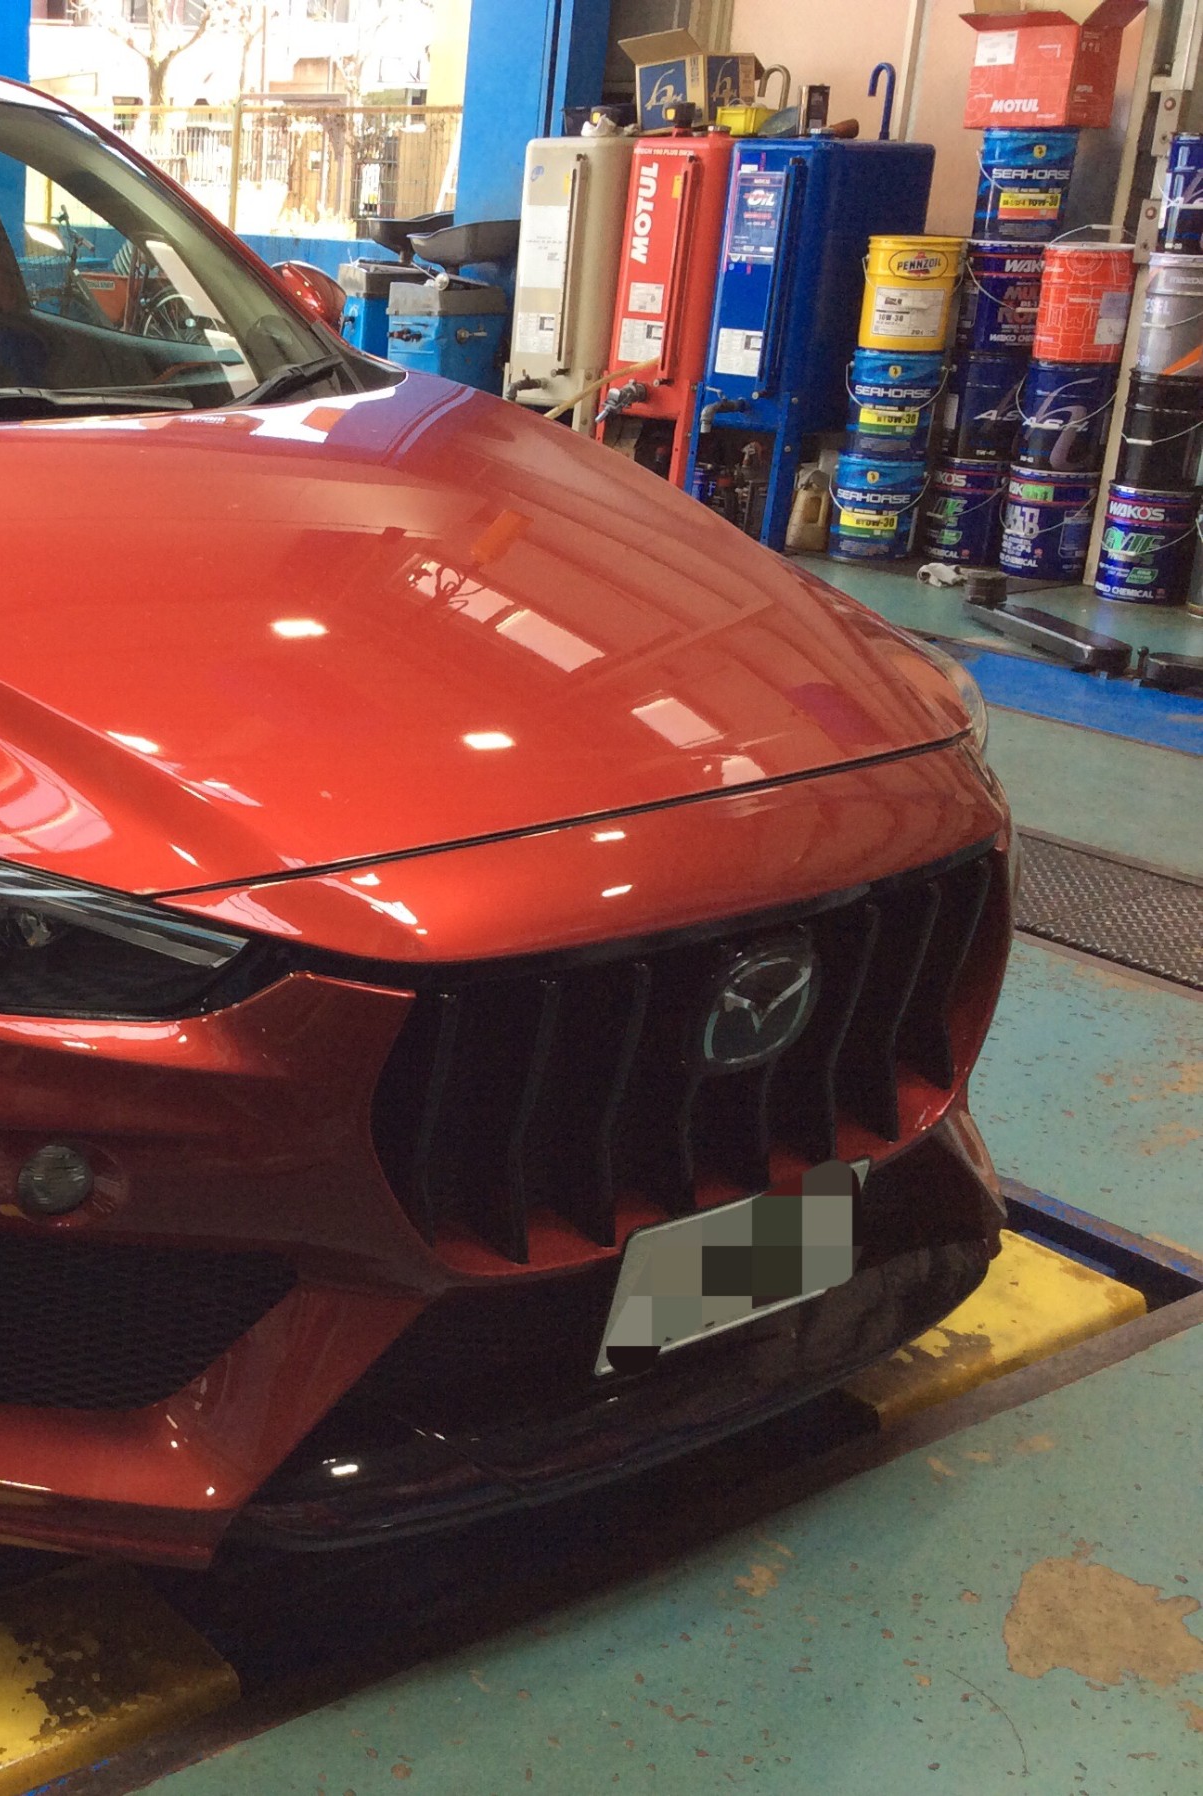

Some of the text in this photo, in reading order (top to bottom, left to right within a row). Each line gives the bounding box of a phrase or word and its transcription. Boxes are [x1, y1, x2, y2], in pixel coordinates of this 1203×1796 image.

[990, 98, 1039, 113] MOTUL
[992, 168, 1071, 180] SEAHORSE
[630, 162, 659, 265] MOTUL
[896, 258, 941, 271] PENNZOIL
[855, 384, 931, 398] SEAHORSE
[837, 487, 911, 503] SEAHORSE
[1109, 500, 1166, 521] WAKO'S
[1111, 586, 1154, 599] CHEMICAL
